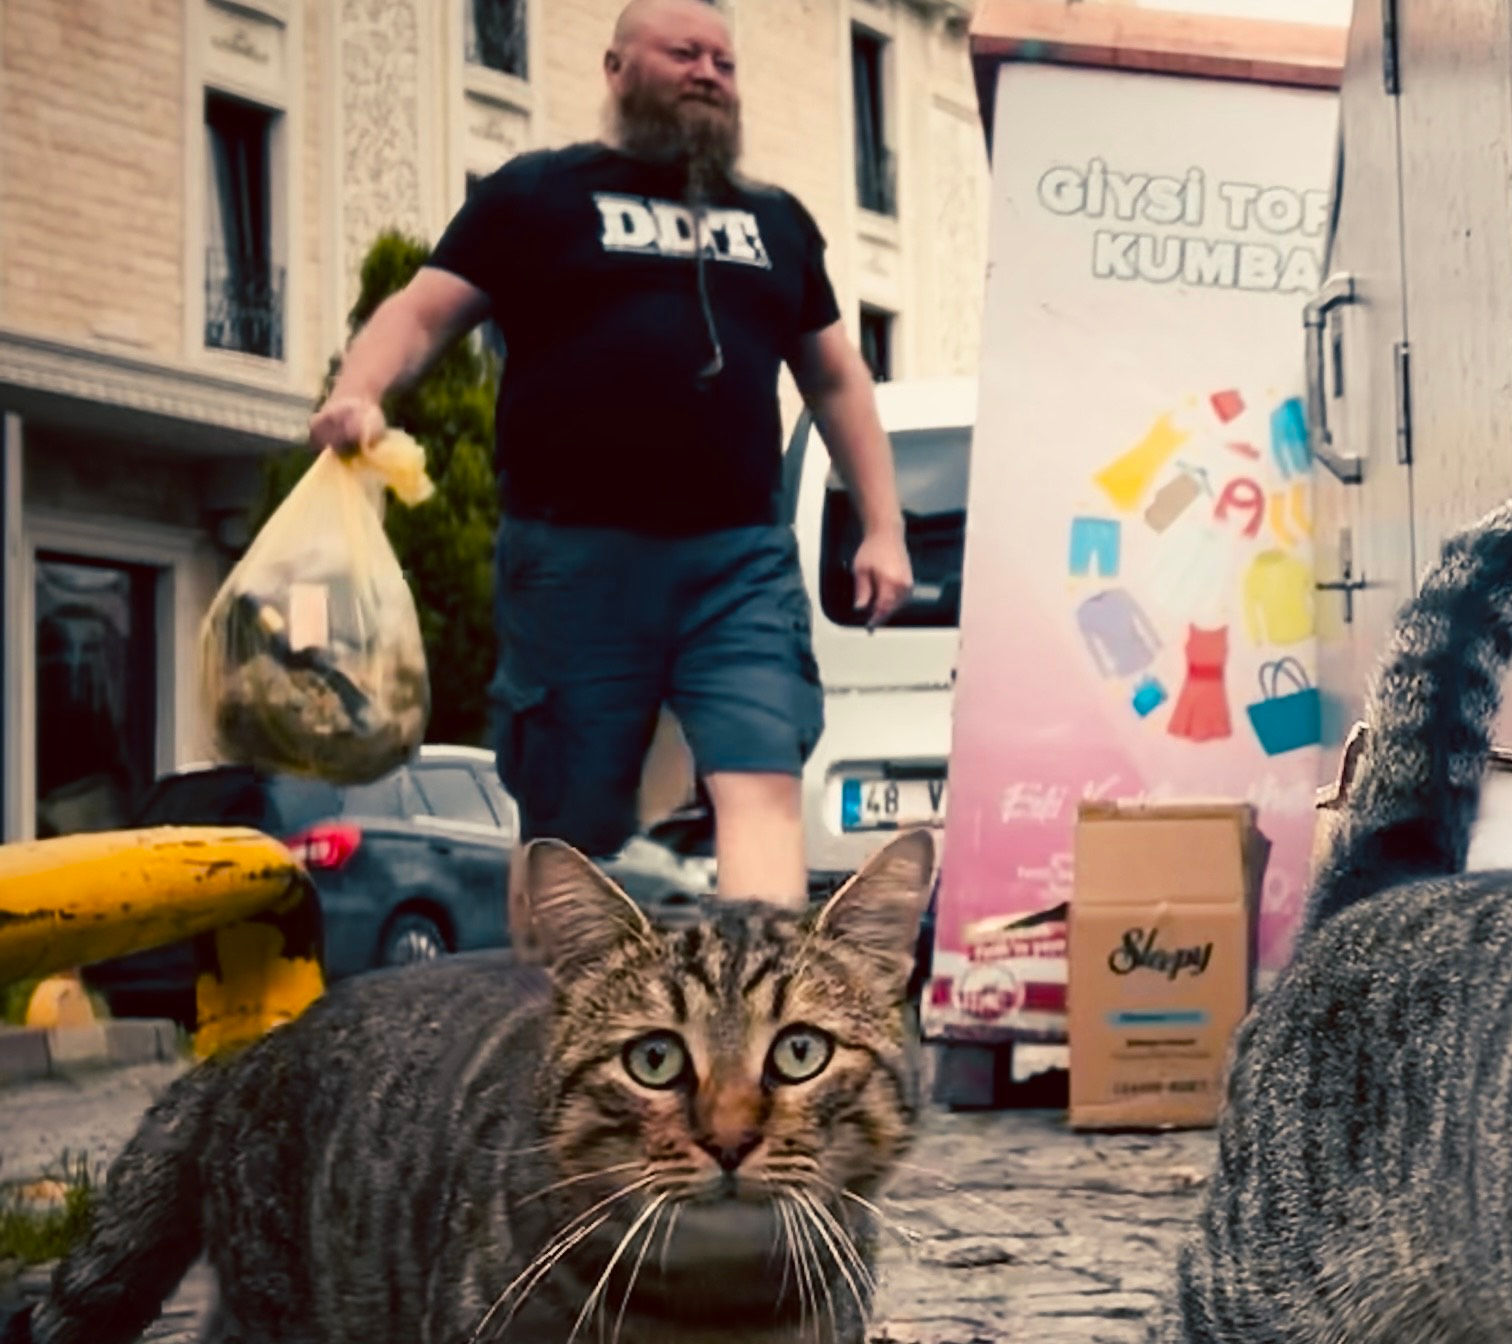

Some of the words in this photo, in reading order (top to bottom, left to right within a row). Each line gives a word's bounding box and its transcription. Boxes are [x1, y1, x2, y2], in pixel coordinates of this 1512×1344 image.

[1037, 156, 1205, 228] GİYSİ
[1092, 229, 1320, 296] KUMBA
[866, 781, 899, 814] 48
